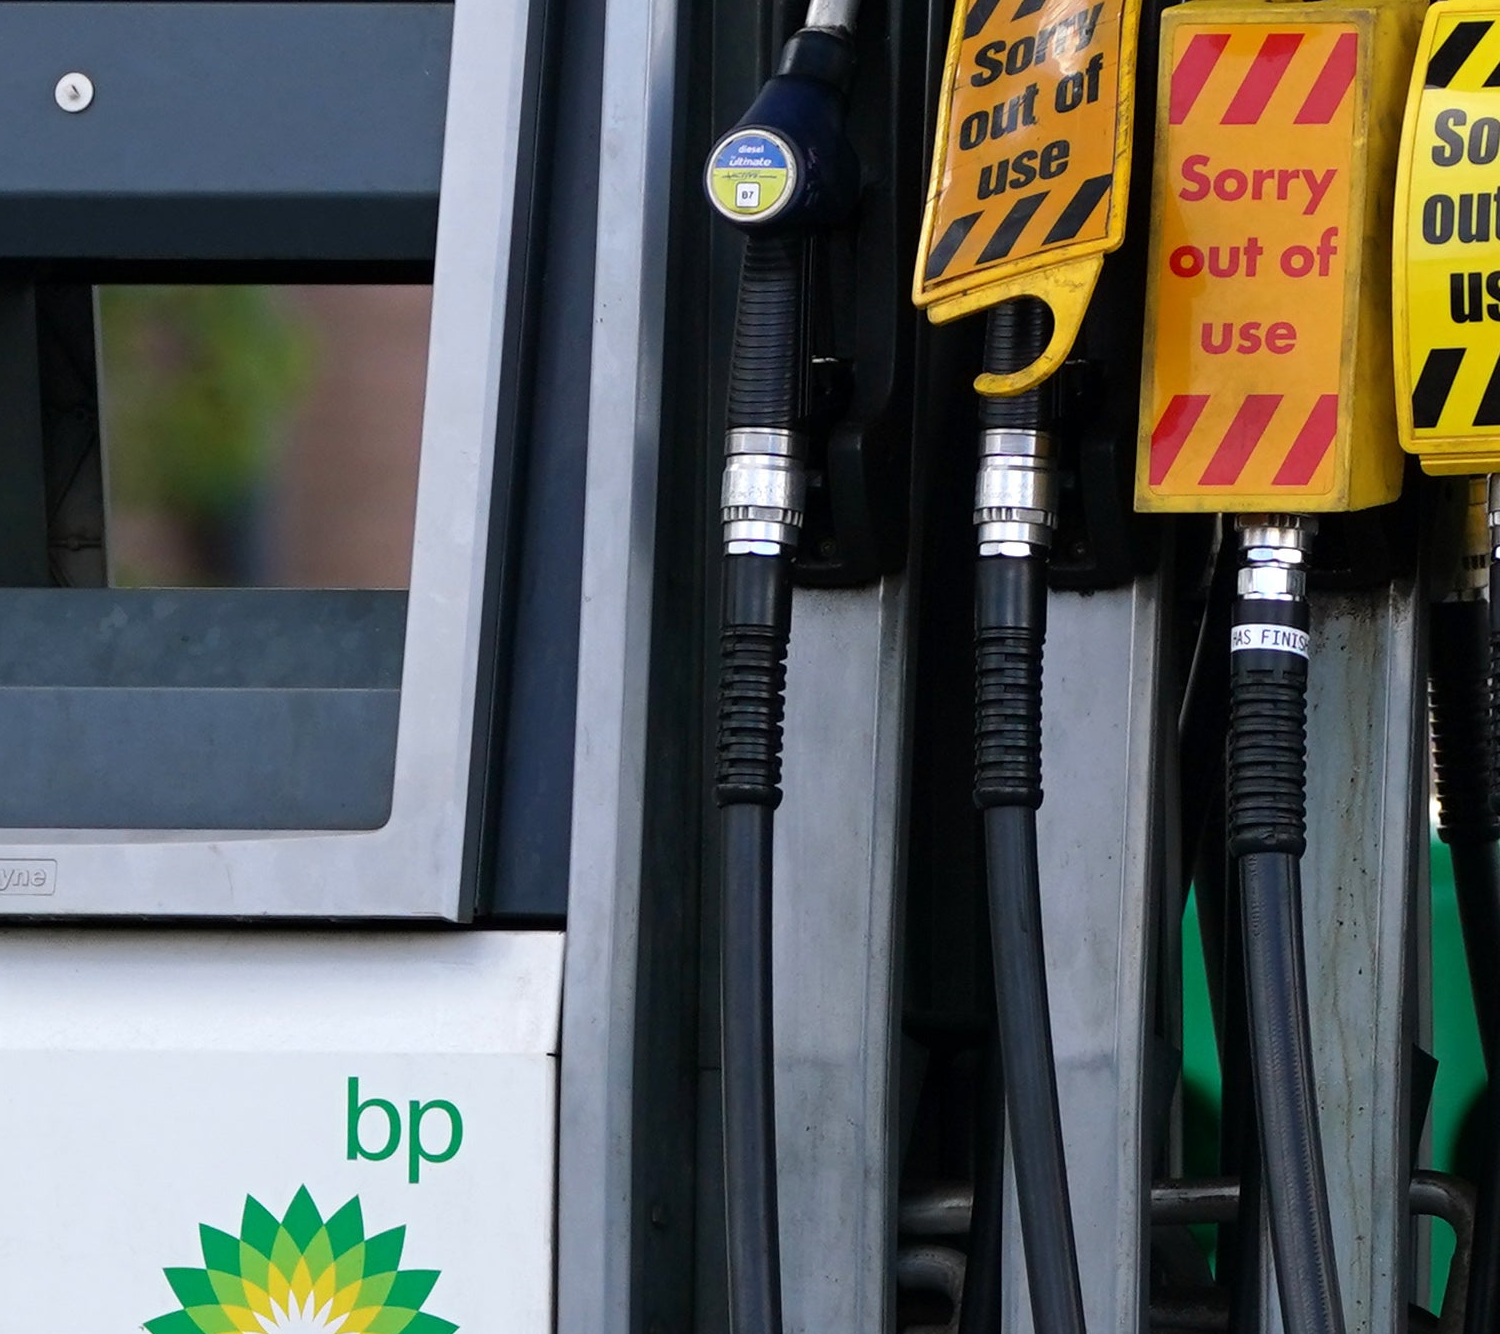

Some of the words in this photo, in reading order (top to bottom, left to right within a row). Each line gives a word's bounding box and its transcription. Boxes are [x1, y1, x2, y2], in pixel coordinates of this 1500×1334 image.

[972, 0, 1104, 89] Sorry
[960, 90, 1041, 152] out
[1054, 52, 1105, 116] of
[738, 145, 764, 153] diesel
[978, 133, 1071, 201] use
[1178, 154, 1339, 216] Sorry
[1168, 234, 1270, 280] out
[1279, 226, 1339, 278] of
[1200, 320, 1298, 356] use
[347, 1077, 463, 1183] bp
